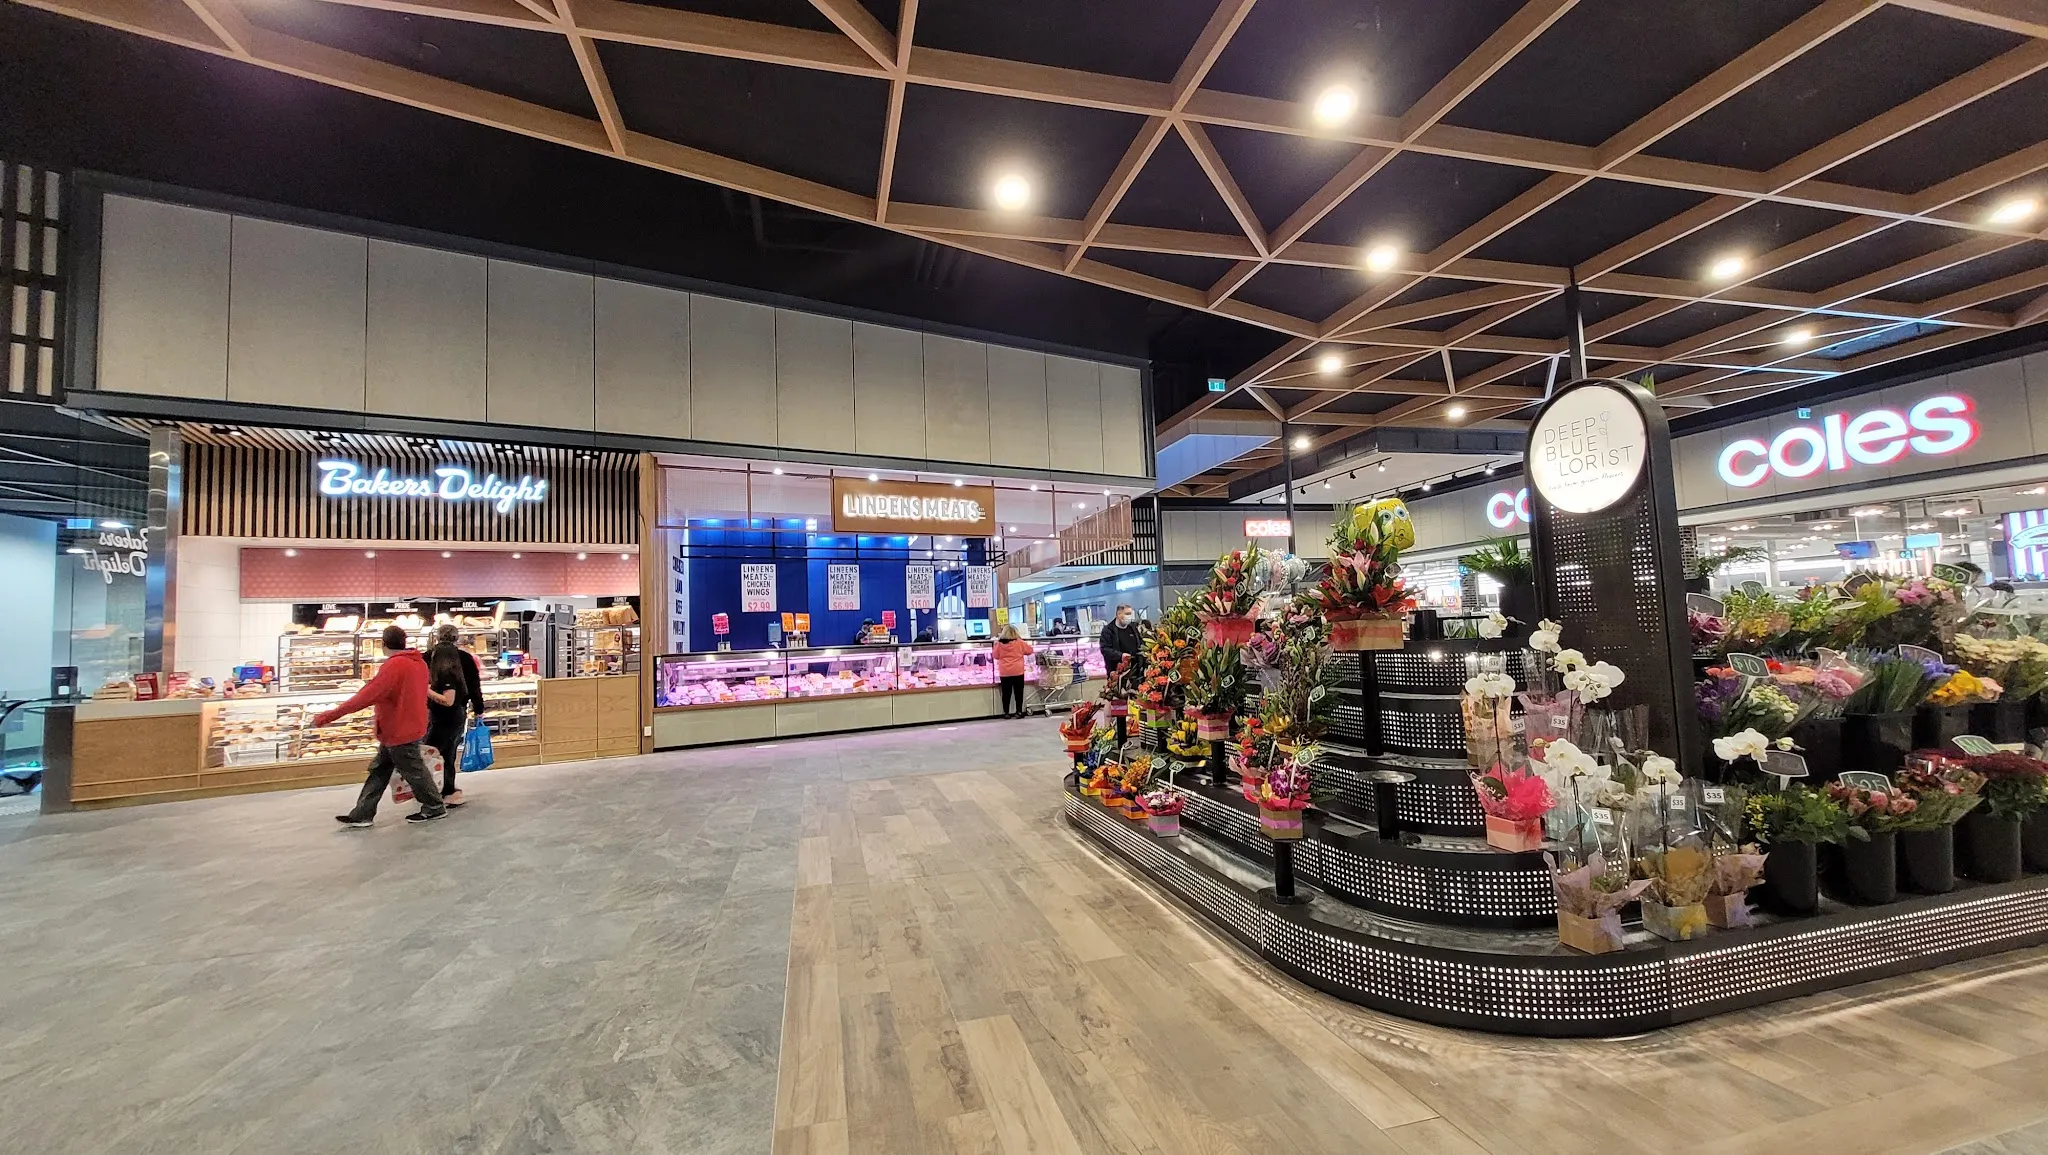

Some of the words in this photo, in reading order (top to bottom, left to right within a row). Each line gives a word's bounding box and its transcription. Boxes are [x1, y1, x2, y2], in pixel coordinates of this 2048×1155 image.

[1544, 416, 1596, 444] DEEP
[1546, 435, 1598, 461] BLUE
[1717, 395, 1976, 488] coles
[1553, 444, 1634, 477] LORIST
[317, 460, 432, 497] Bakers
[434, 466, 548, 514] Delight
[845, 494, 922, 519] LINDENS
[924, 497, 980, 522] MEATS
[1247, 519, 1291, 536] coles
[743, 565, 774, 573] LINDENS
[1933, 565, 1967, 582] $20
[746, 588, 770, 596] WINGS
[747, 601, 771, 612] $2.99
[1732, 656, 1761, 674] $10
[1553, 718, 1566, 726] $35
[1706, 792, 1722, 800] $35
